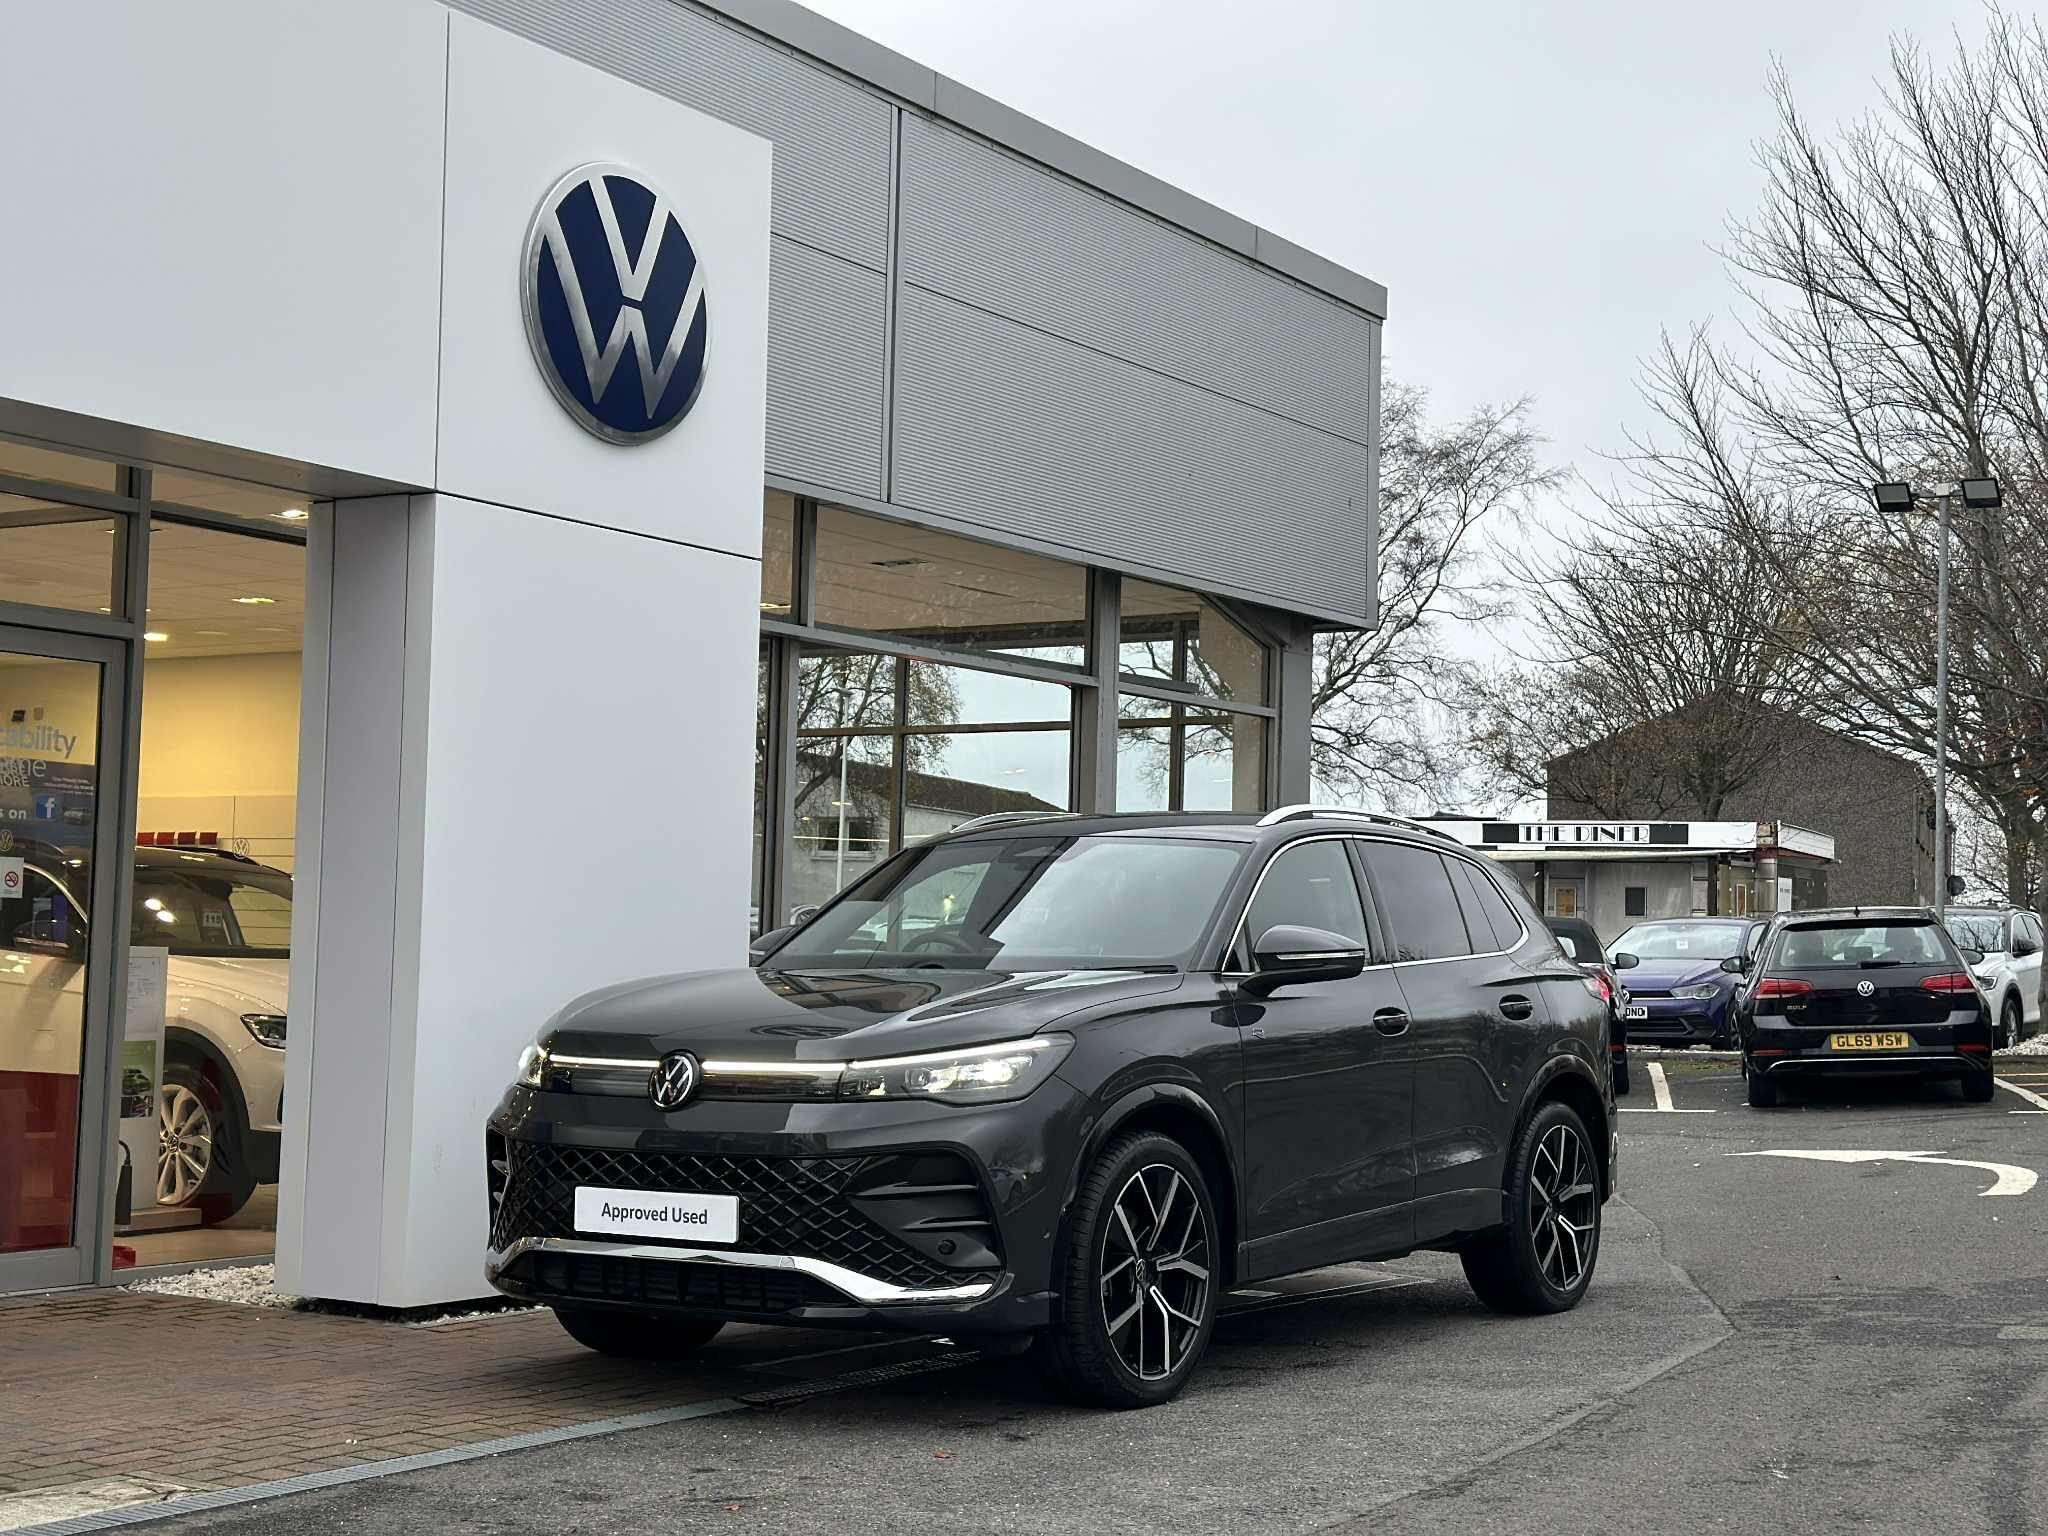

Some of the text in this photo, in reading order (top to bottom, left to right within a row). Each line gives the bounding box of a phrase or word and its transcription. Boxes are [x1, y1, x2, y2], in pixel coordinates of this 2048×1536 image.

[8, 808, 27, 819] on
[1521, 825, 1650, 843] THE DINER
[1836, 1033, 1903, 1048] GL69 WSW
[601, 1202, 708, 1225] Approved Used
